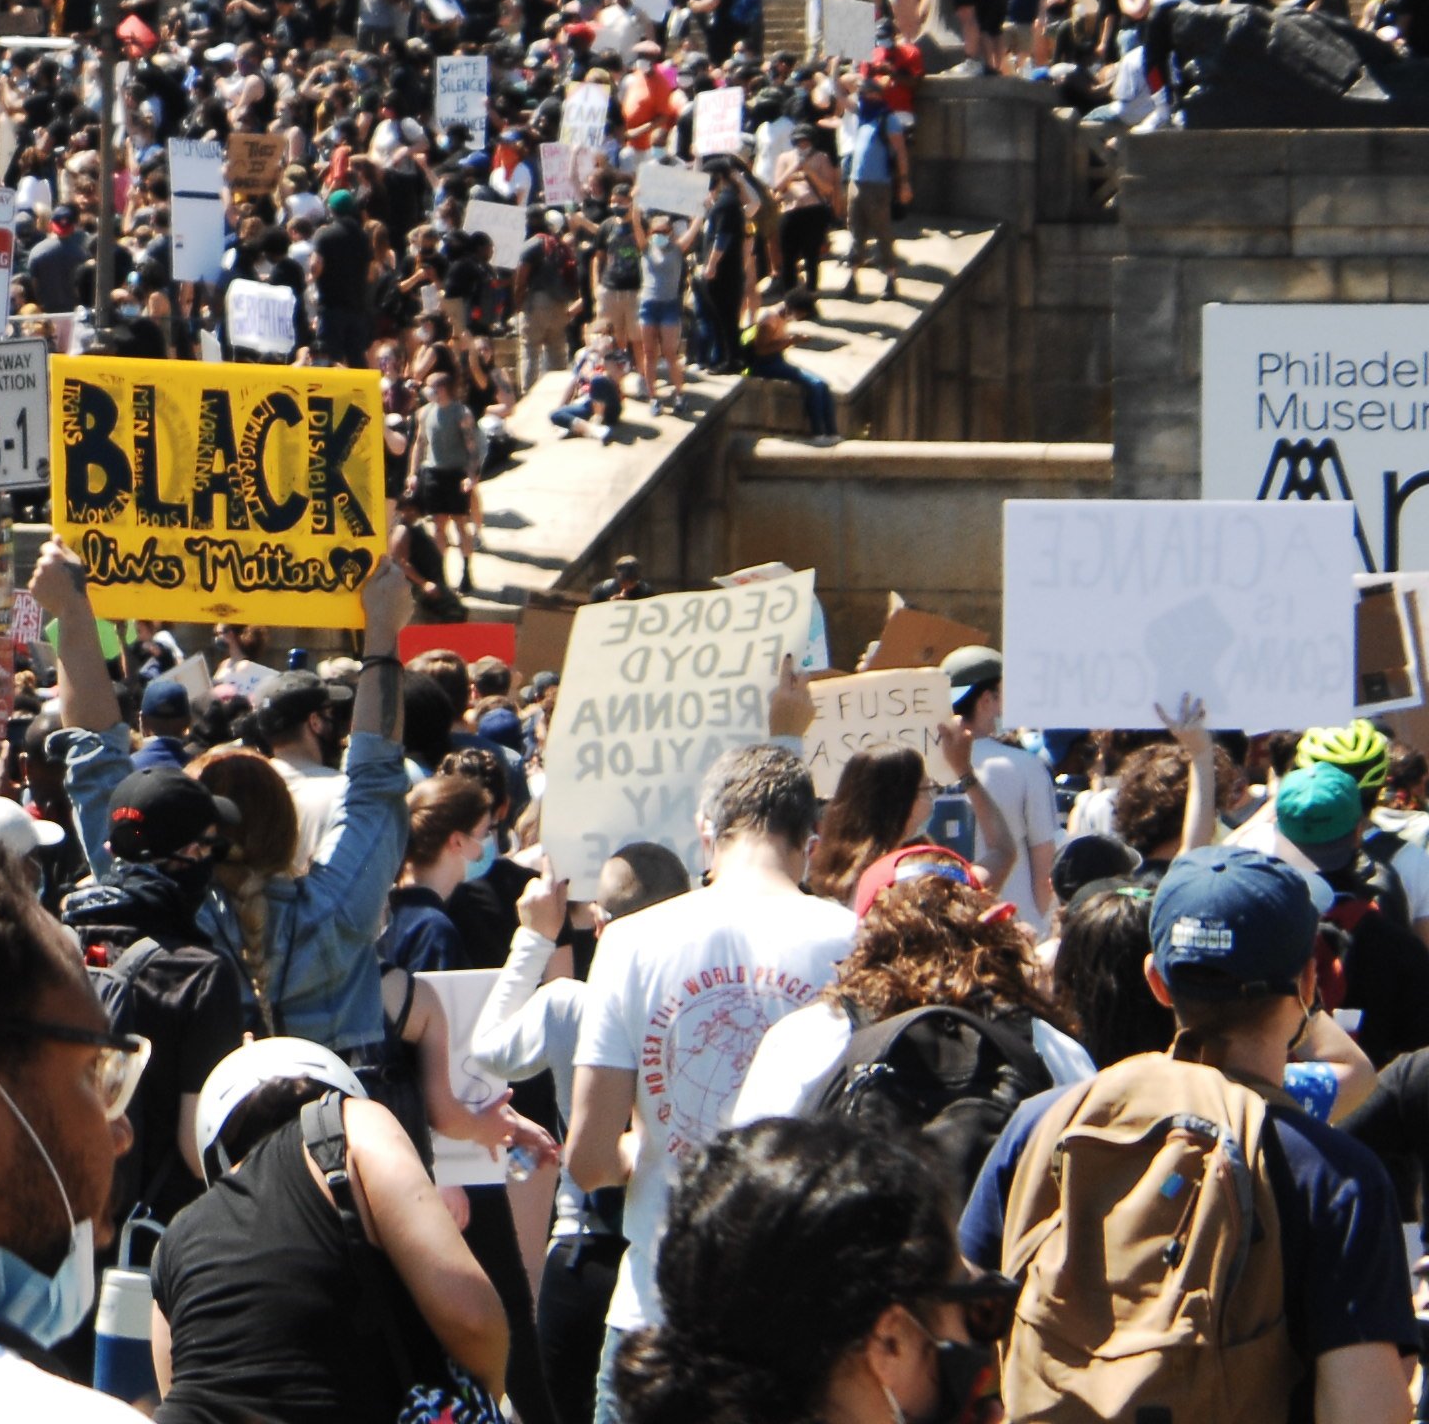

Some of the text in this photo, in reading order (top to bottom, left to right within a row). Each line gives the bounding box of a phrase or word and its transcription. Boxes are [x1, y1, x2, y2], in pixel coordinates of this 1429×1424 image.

[441, 78, 485, 93] SILENCE
[442, 62, 479, 77] WHITE
[63, 382, 83, 446] TRANS
[63, 378, 378, 537] BLACK
[195, 398, 220, 492] WORKING
[238, 398, 276, 527] IMMIGRANT
[307, 410, 329, 533] DISABLED
[68, 488, 132, 525] WOMEN
[683, 965, 747, 997] WORLD
[643, 1034, 664, 1067] SEX
[644, 1072, 666, 1096] NO
